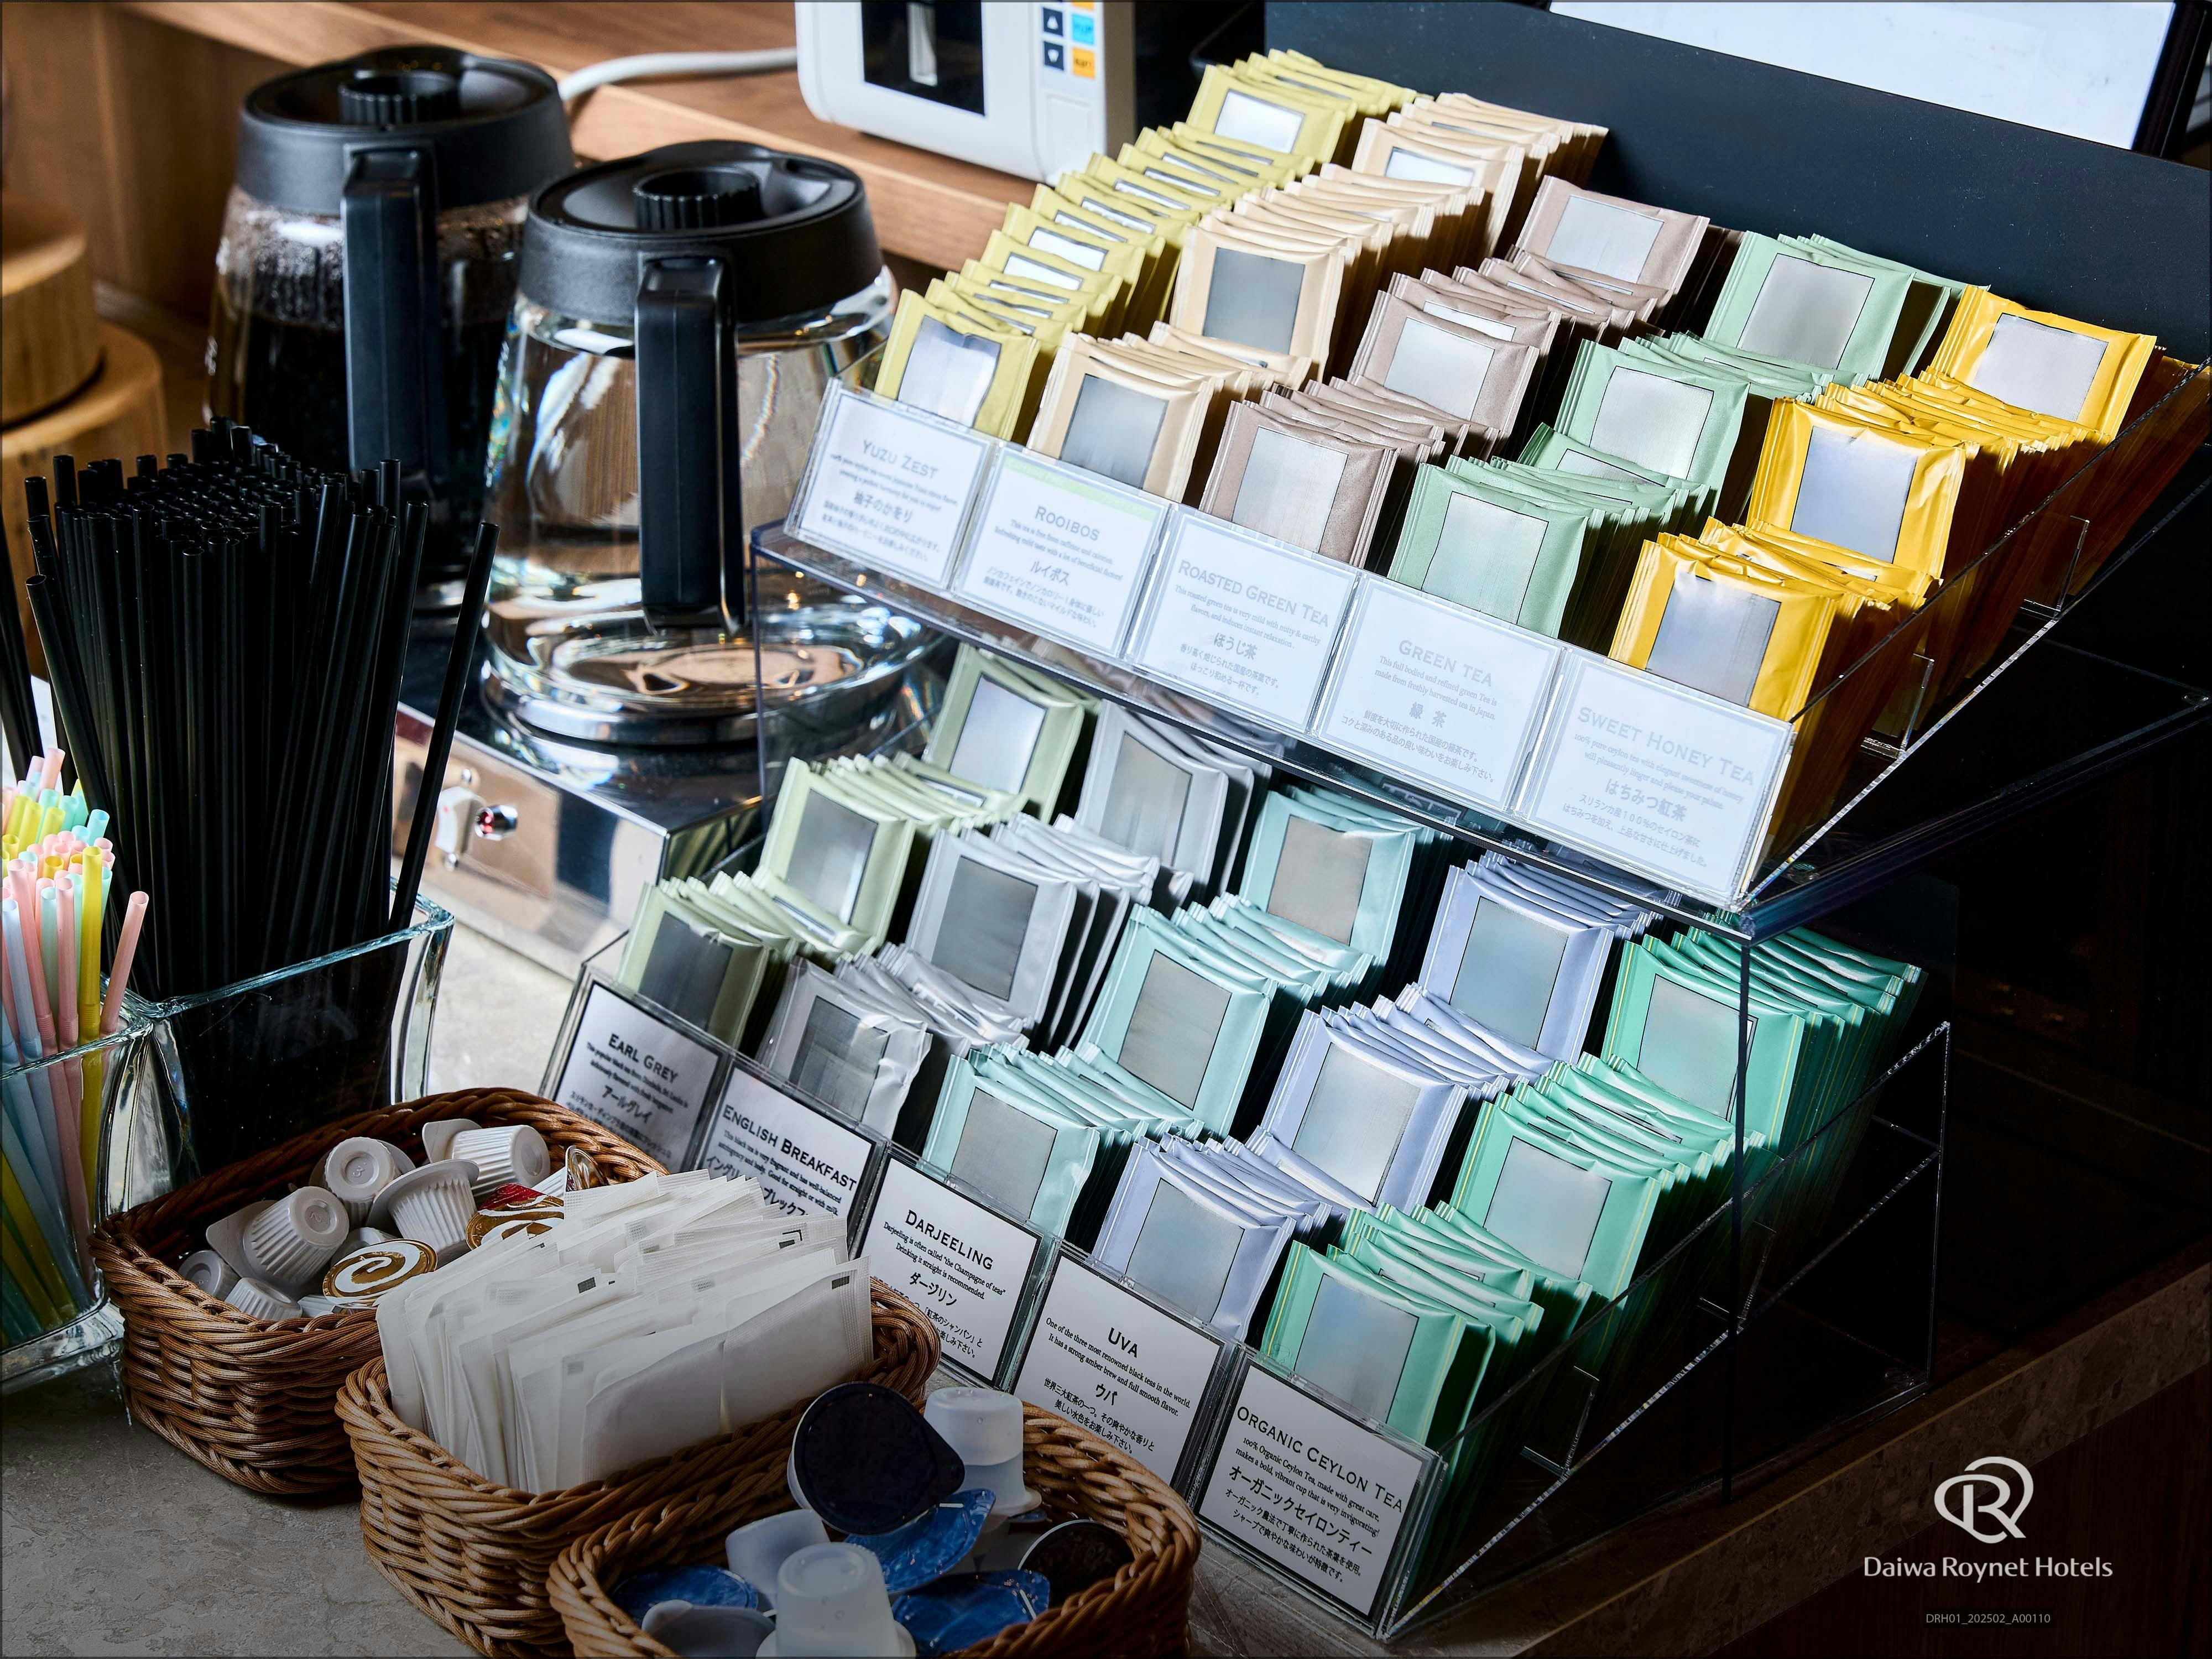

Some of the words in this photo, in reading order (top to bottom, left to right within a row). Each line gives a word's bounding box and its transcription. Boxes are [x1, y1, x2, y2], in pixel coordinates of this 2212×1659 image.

[862, 439, 898, 465] YUZU
[900, 454, 938, 478] ZEST
[1034, 504, 1100, 541] ROOIBOS
[1177, 559, 1243, 594] ROASTED
[1245, 585, 1297, 615] GREEN
[1301, 603, 1328, 628] TEA
[1213, 632, 1258, 660] ほうじ茶
[1398, 639, 1457, 673] GREEN
[1462, 662, 1491, 687] TEA
[1374, 669, 1392, 680] made
[1391, 674, 1407, 686] from
[1406, 679, 1429, 697] freshly
[1428, 687, 1459, 706] harvested
[1458, 700, 1468, 709] tea
[1468, 703, 1476, 713] in
[1474, 706, 1495, 721] Japan.
[1379, 655, 1392, 667] This
[1391, 660, 1405, 671] full
[1404, 664, 1425, 679] bodied
[1424, 674, 1438, 684] and
[1436, 679, 1460, 692] refined
[1458, 687, 1478, 700] green
[1478, 692, 1490, 704] Tea
[1490, 697, 1497, 707] is
[1340, 715, 1494, 782] コクと深みのある品の良い味わいをお楽しみ下さい。
[1363, 709, 1477, 762] 鮮度を大切に作られた国産の緑茶です。
[1576, 706, 1643, 742] SWEET
[1645, 731, 1714, 768] HONEY
[1719, 756, 1754, 786] TEA
[1604, 778, 1687, 822] はちみつ紅茶
[608, 1032, 639, 1063] EARL
[643, 1054, 678, 1082] GREY
[601, 1084, 653, 1123] アールグレイ
[722, 1104, 779, 1147] ENGLISH
[780, 1138, 857, 1191] BREAKFAST
[883, 1220, 909, 1244] Darjeeling
[908, 1236, 914, 1244] is
[913, 1240, 927, 1253] often
[927, 1249, 943, 1261] called
[953, 1262, 985, 1286] Champagne
[904, 1209, 993, 1270] DARJEELING
[895, 1242, 918, 1263] Drinking
[917, 1255, 923, 1264] it
[922, 1259, 942, 1275] straight
[941, 1269, 947, 1278] is
[947, 1274, 985, 1300] recommended.
[909, 1271, 957, 1306] ダージリン
[937, 1327, 975, 1358] 楽しみ下さい。
[1045, 1317, 1058, 1329] One
[1063, 1328, 1073, 1339] the
[1073, 1333, 1088, 1348] three
[1087, 1343, 1102, 1356] most
[1100, 1352, 1129, 1372] renowned
[1128, 1365, 1144, 1381] black
[1144, 1376, 1156, 1388] teas
[1155, 1382, 1162, 1392] in
[1162, 1386, 1173, 1398] the
[1173, 1394, 1191, 1408] world.
[1107, 1326, 1138, 1358] UVA
[1047, 1332, 1054, 1342] It
[1053, 1335, 1064, 1348] has
[1067, 1346, 1086, 1363] strong
[1084, 1357, 1104, 1371] amber
[1102, 1365, 1118, 1379] brew
[1116, 1375, 1129, 1386] and
[1127, 1380, 1140, 1394] full
[1138, 1389, 1160, 1406] smooth
[1160, 1400, 1178, 1417] flavor.
[1095, 1383, 1118, 1406] ウバ
[1053, 1398, 1133, 1454] 美しい水色をお楽しみ下さい。
[1235, 1447, 1255, 1463] makes
[1259, 1459, 1274, 1476] bold,
[1274, 1470, 1296, 1488] vibrant
[1295, 1483, 1307, 1496] cup
[1307, 1489, 1320, 1502] that
[1319, 1496, 1326, 1505] is
[1327, 1501, 1340, 1515] very
[1237, 1406, 1303, 1453] ORGANIC
[1306, 1447, 1369, 1492] CEYLON
[1375, 1482, 1402, 1513] TEA
[1242, 1437, 1259, 1451] 100%
[1258, 1444, 1282, 1464] Organic
[1282, 1459, 1303, 1477] Ceylon
[1303, 1470, 1316, 1486] Tea,
[1316, 1480, 1334, 1495] made
[1334, 1490, 1348, 1503] with
[1347, 1499, 1365, 1513] great
[1228, 1465, 1372, 1554] オーガニックセイロンティー
[1232, 1508, 1343, 1583] シャープで爽やかな味わいが特徴です。
